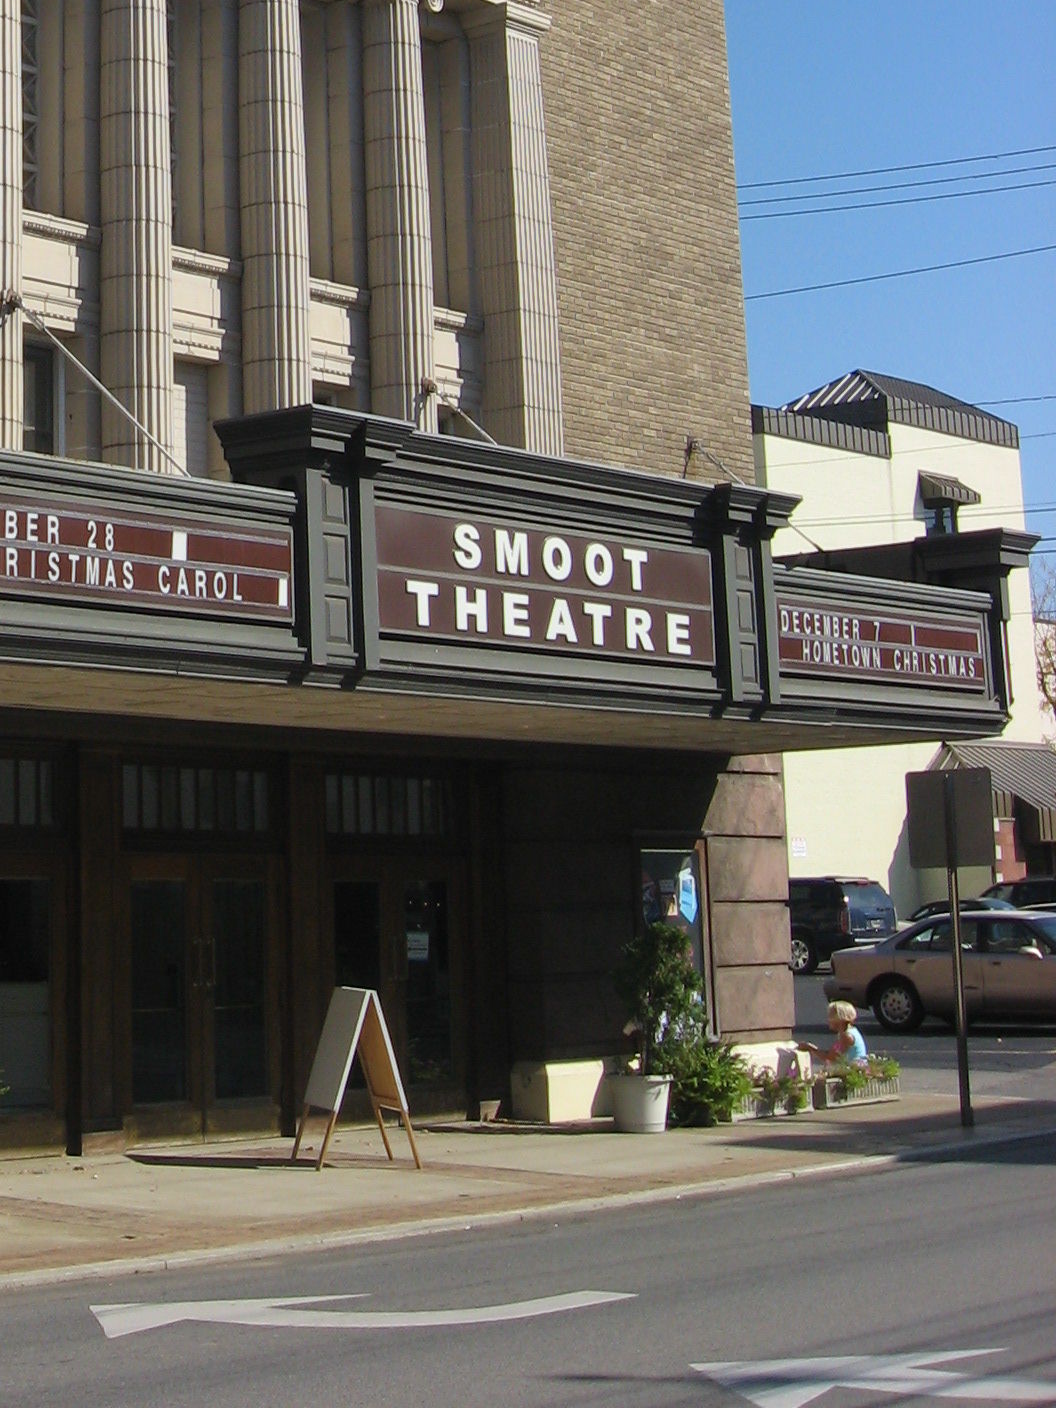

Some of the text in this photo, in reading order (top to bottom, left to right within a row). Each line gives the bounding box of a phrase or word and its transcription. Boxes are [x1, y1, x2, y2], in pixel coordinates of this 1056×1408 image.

[87, 520, 115, 552] 28
[453, 523, 648, 592] SMOOT
[158, 565, 243, 601] CAROL
[405, 579, 692, 656] THEATRE
[780, 610, 881, 642] DECEMBER 7
[802, 640, 976, 677] HOMETOWN CHRISTMAS
